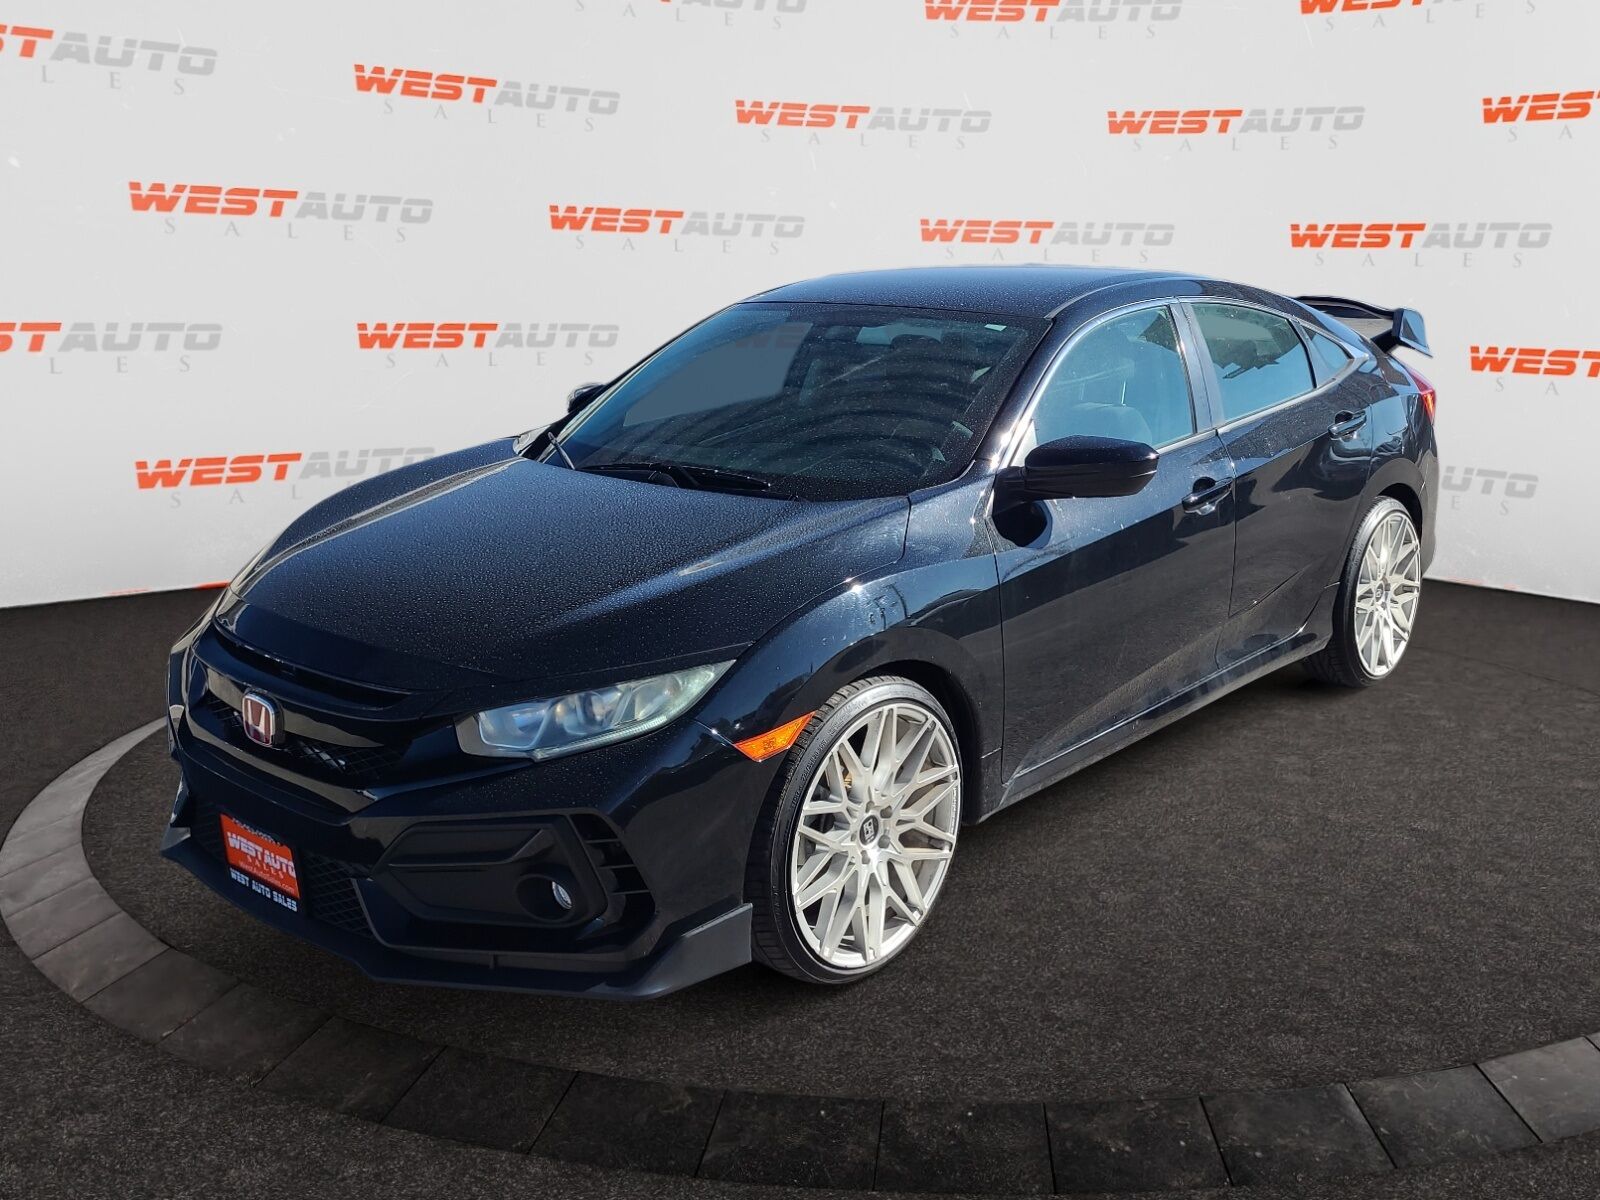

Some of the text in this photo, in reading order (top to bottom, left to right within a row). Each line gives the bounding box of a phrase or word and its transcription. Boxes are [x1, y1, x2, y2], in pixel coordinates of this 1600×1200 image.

[1482, 90, 1600, 123] WES
[230, 867, 249, 887] WEST
[252, 880, 271, 899] AUTO
[273, 891, 298, 912] SALES
